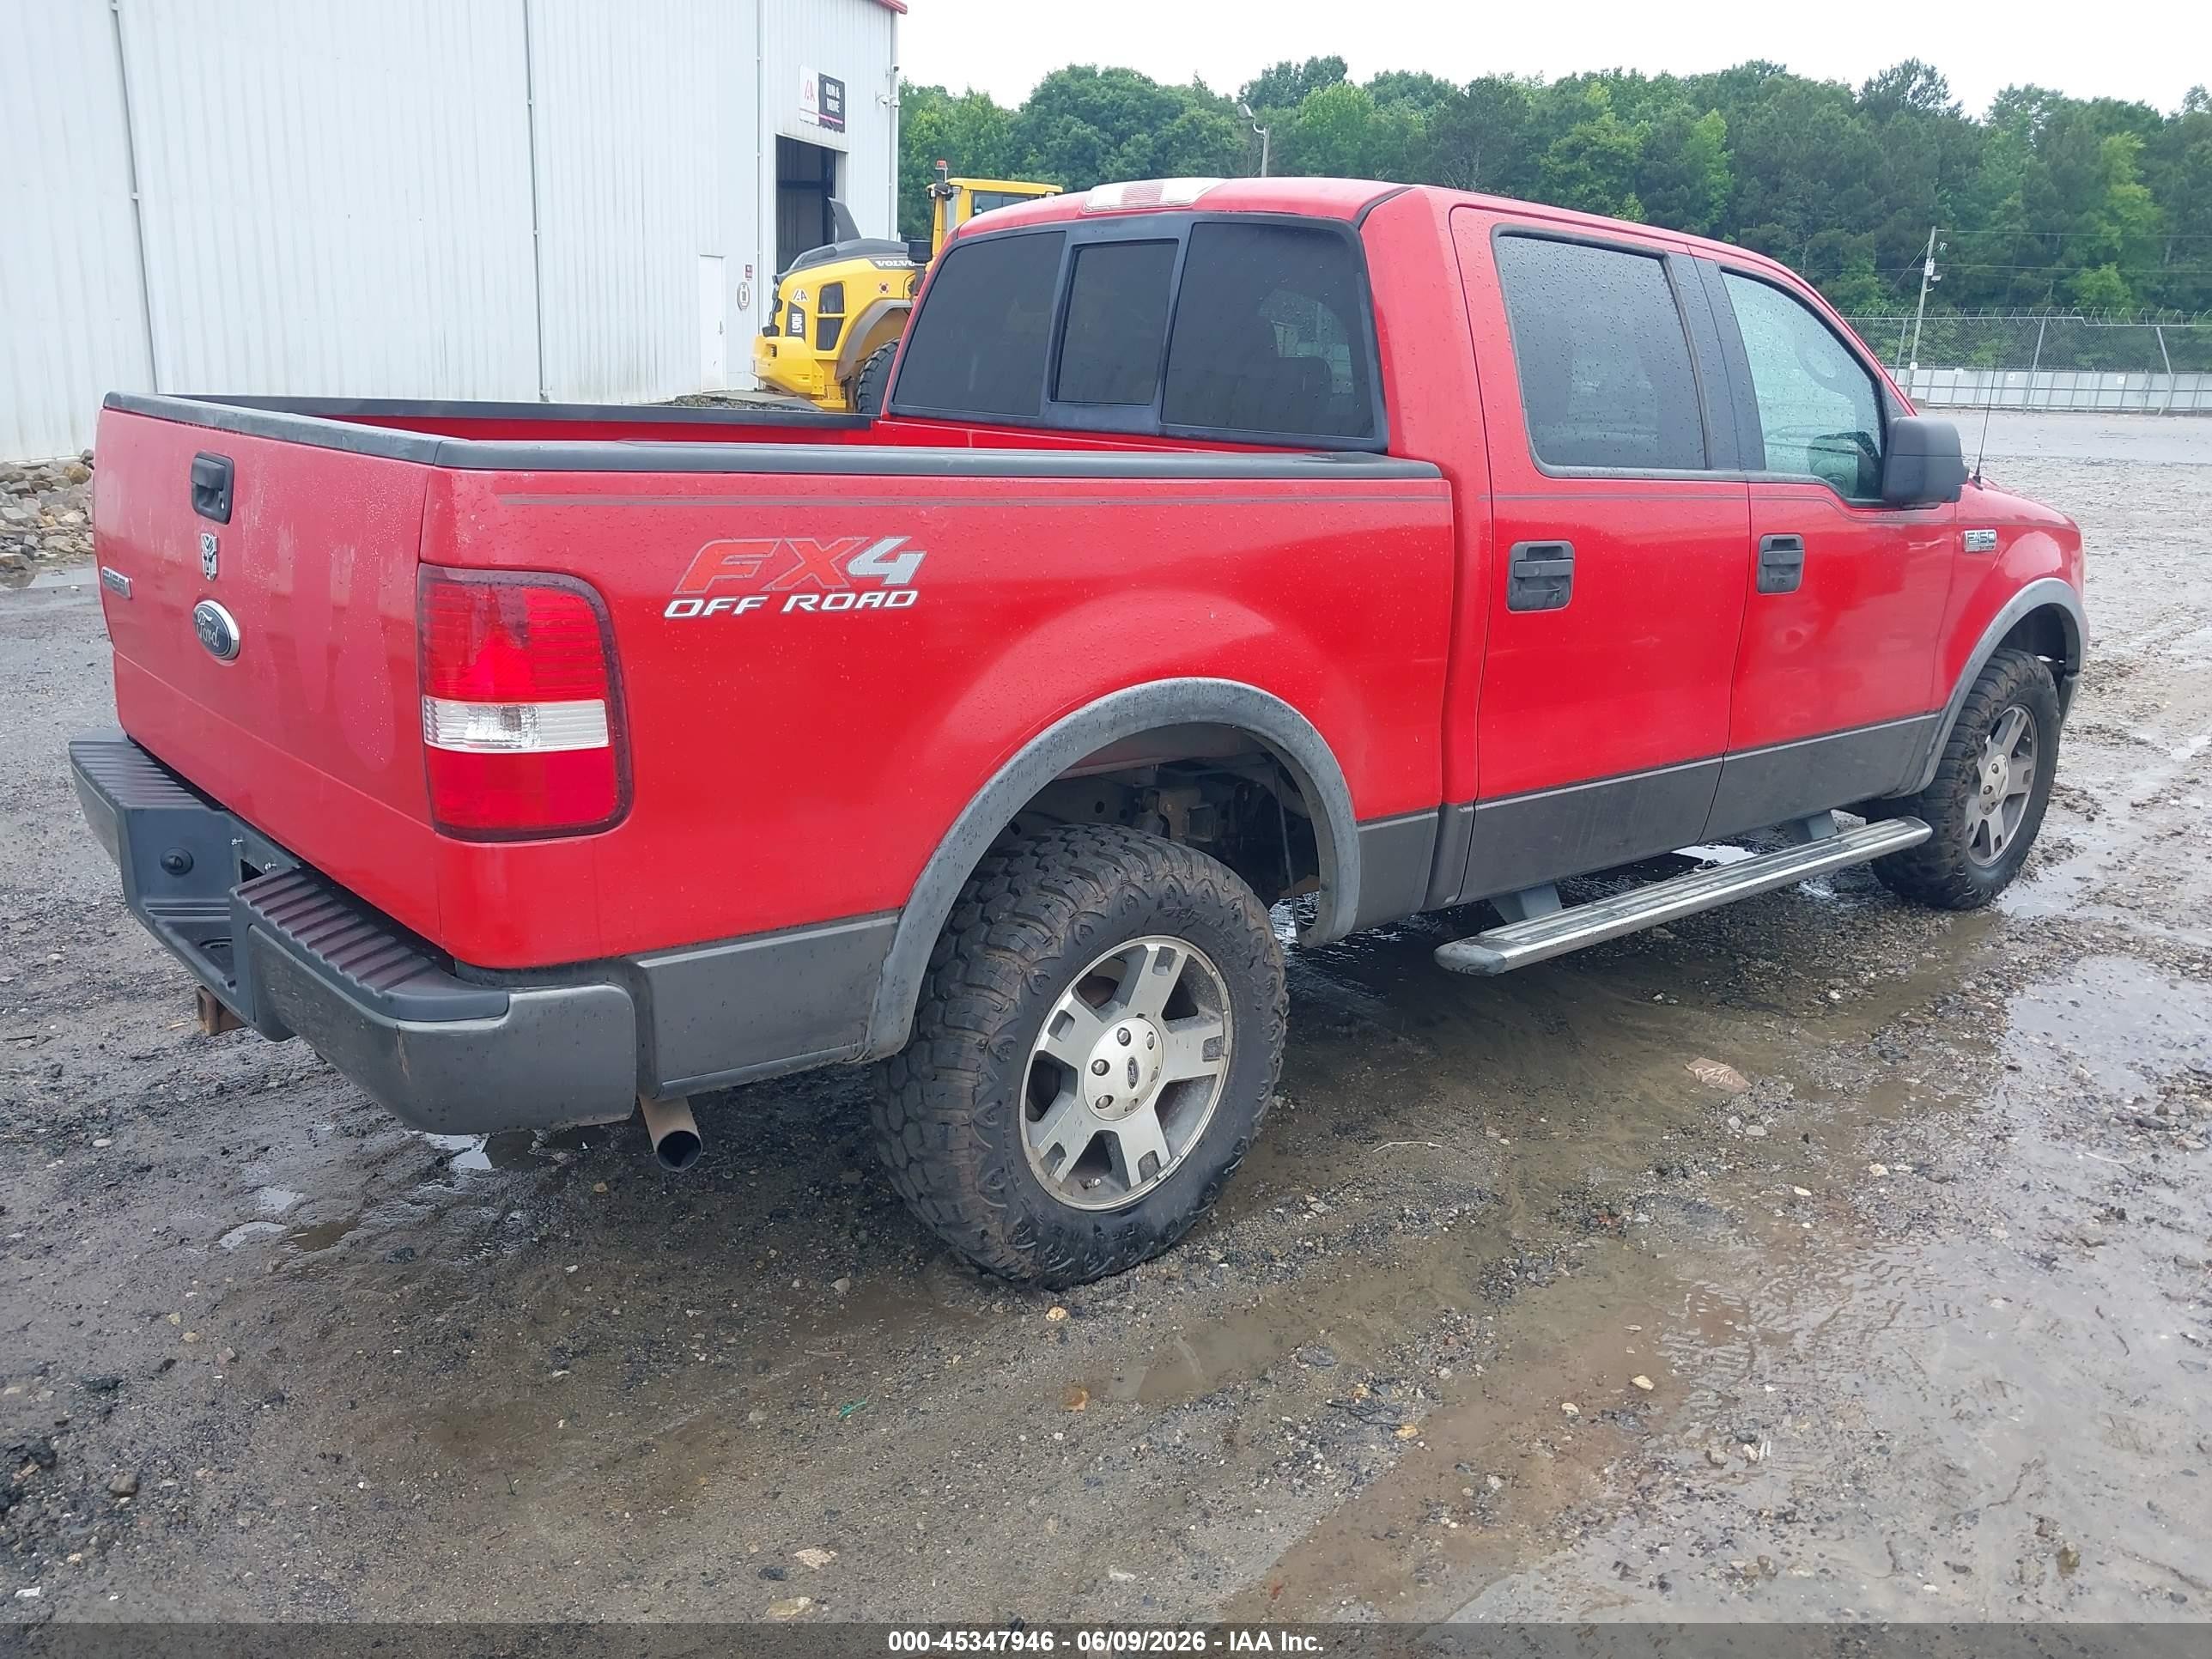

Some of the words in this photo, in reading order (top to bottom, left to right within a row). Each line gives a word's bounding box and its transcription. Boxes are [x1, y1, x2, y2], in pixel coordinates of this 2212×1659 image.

[826, 98, 840, 113] DRIVE
[673, 536, 927, 594] FX4
[663, 595, 770, 619] OFF
[781, 590, 920, 615] ROAD
[196, 610, 221, 648] Ford
